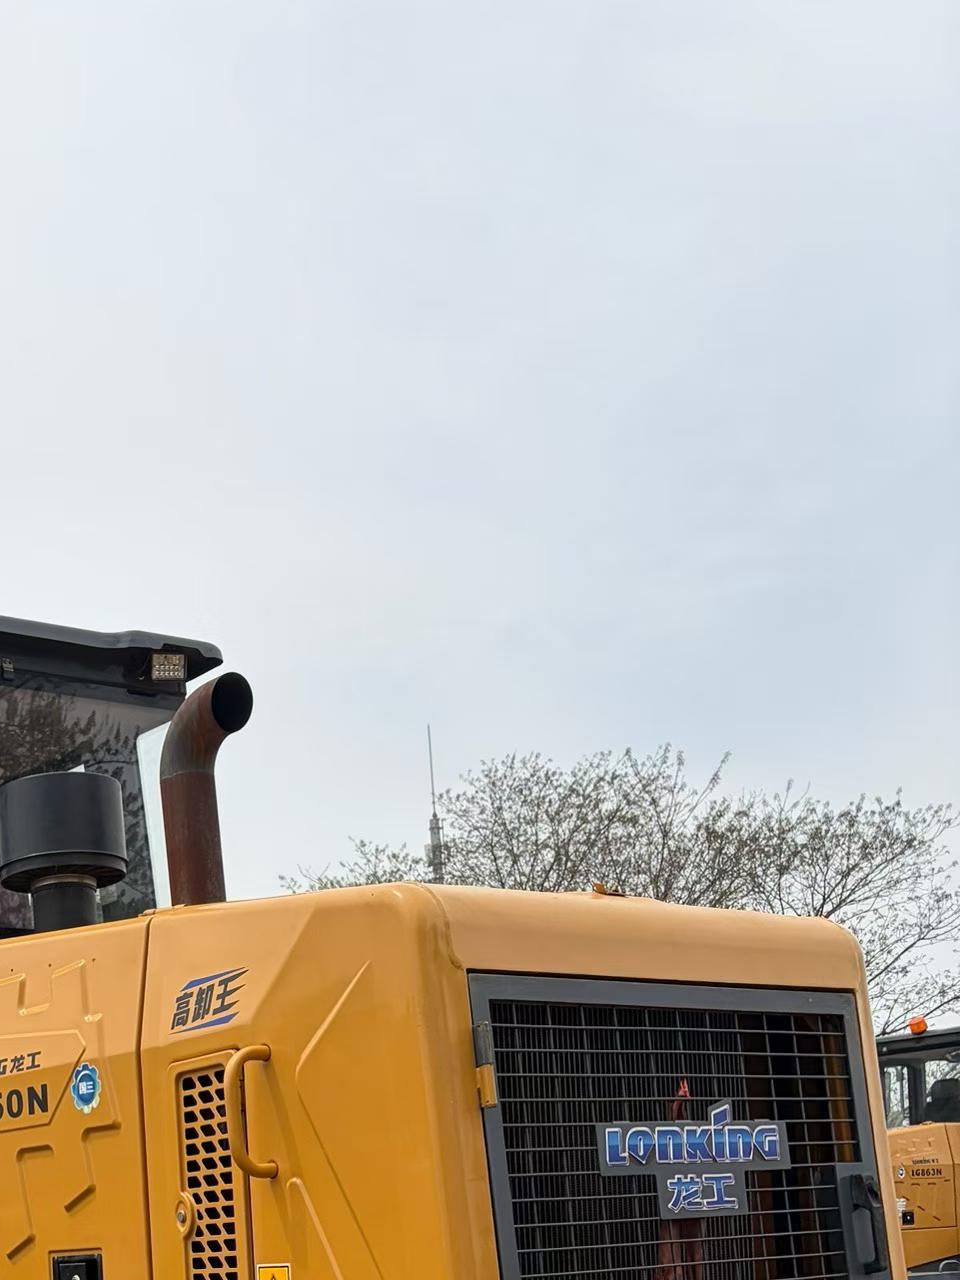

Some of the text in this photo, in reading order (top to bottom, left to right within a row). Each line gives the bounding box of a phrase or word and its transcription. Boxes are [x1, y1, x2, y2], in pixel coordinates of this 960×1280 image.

[10, 1051, 41, 1074] 龙工
[911, 1168, 942, 1177] LG863N
[668, 1173, 739, 1213] 龙工
